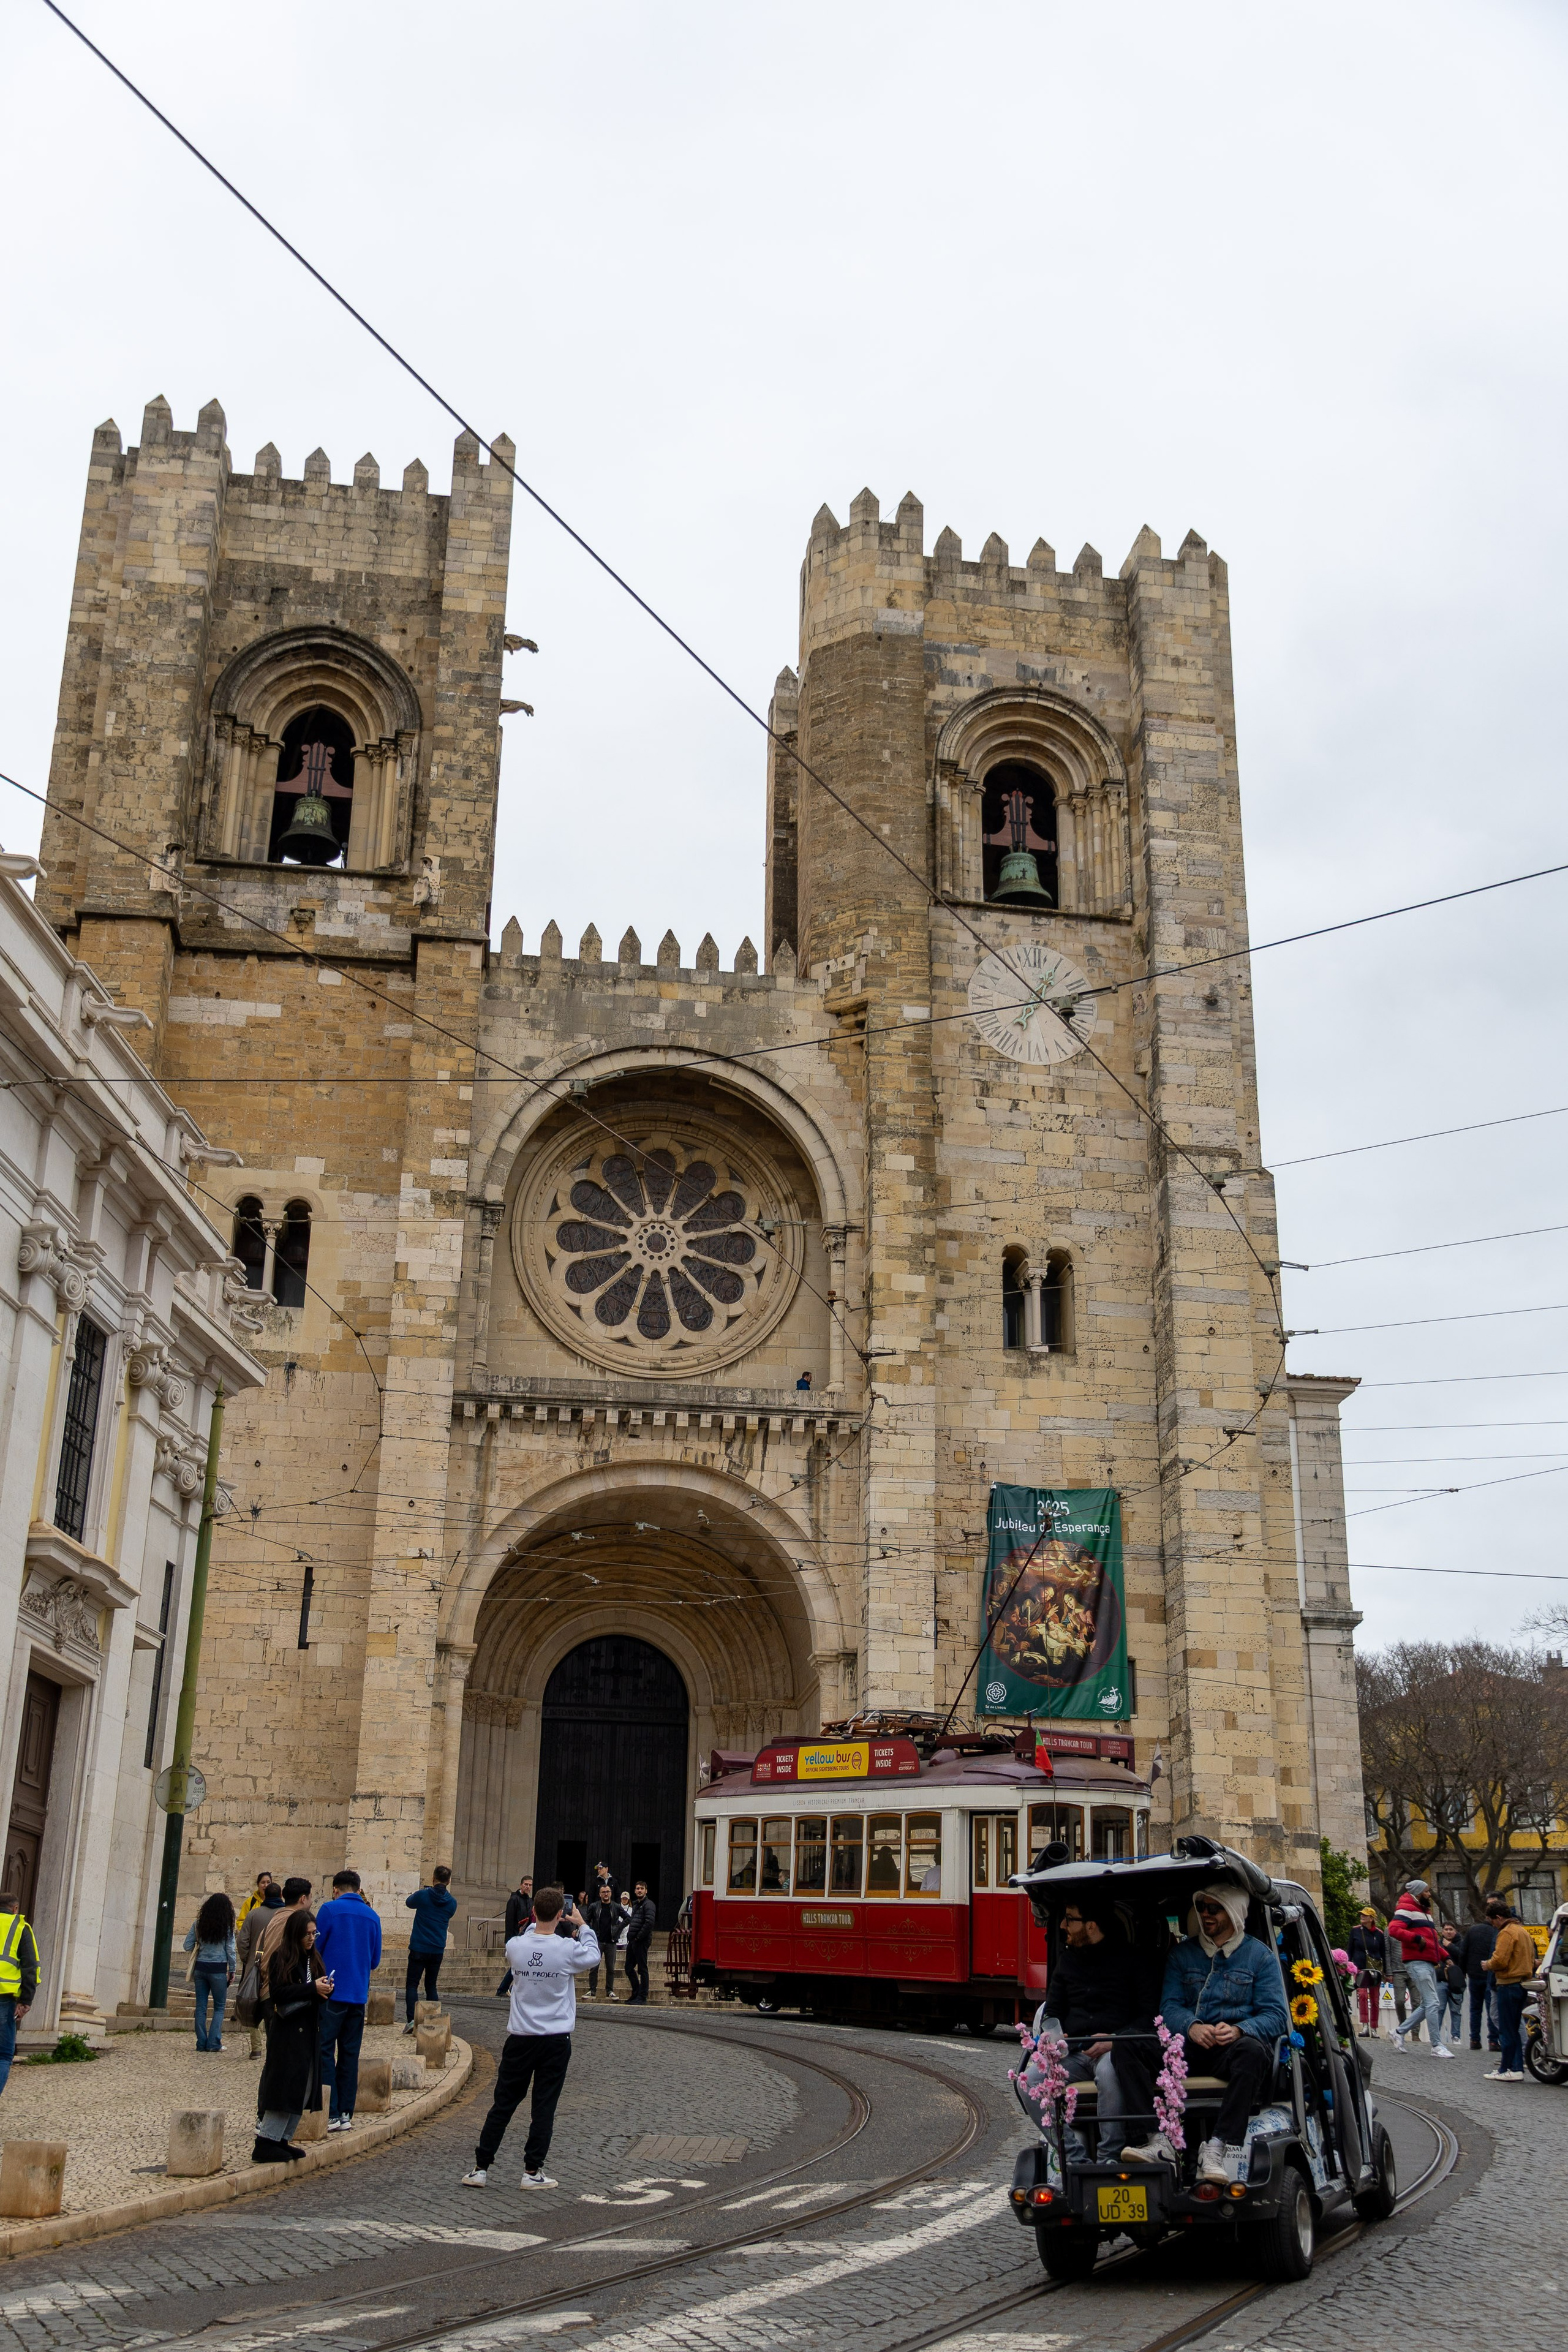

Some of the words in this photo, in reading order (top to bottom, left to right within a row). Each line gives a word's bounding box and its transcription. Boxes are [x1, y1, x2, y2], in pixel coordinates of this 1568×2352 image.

[1022, 947, 1041, 969] XII
[977, 967, 1001, 986] X
[1065, 978, 1087, 992] II
[971, 992, 993, 1007] IX
[975, 1012, 1002, 1039] VIII
[996, 1030, 1020, 1057] VII
[1054, 1039, 1069, 1060] V
[1027, 1041, 1044, 1063] VI
[995, 1517, 1036, 1532] Jubileu
[1054, 1522, 1110, 1536] Esperança
[1042, 1737, 1057, 1746] HILLS
[1058, 1739, 1079, 1748] TRAMCAR
[1080, 1741, 1093, 1749] TOUR
[805, 1751, 834, 1765] yellow
[836, 1750, 851, 1763] bus
[873, 1748, 894, 1757] TICKETS
[875, 1759, 892, 1768] INSIDE
[803, 1913, 816, 1923] HILLS
[818, 1913, 838, 1924] TRAMCAR
[839, 1914, 851, 1924] TOUR
[1112, 2188, 1129, 2204] 20
